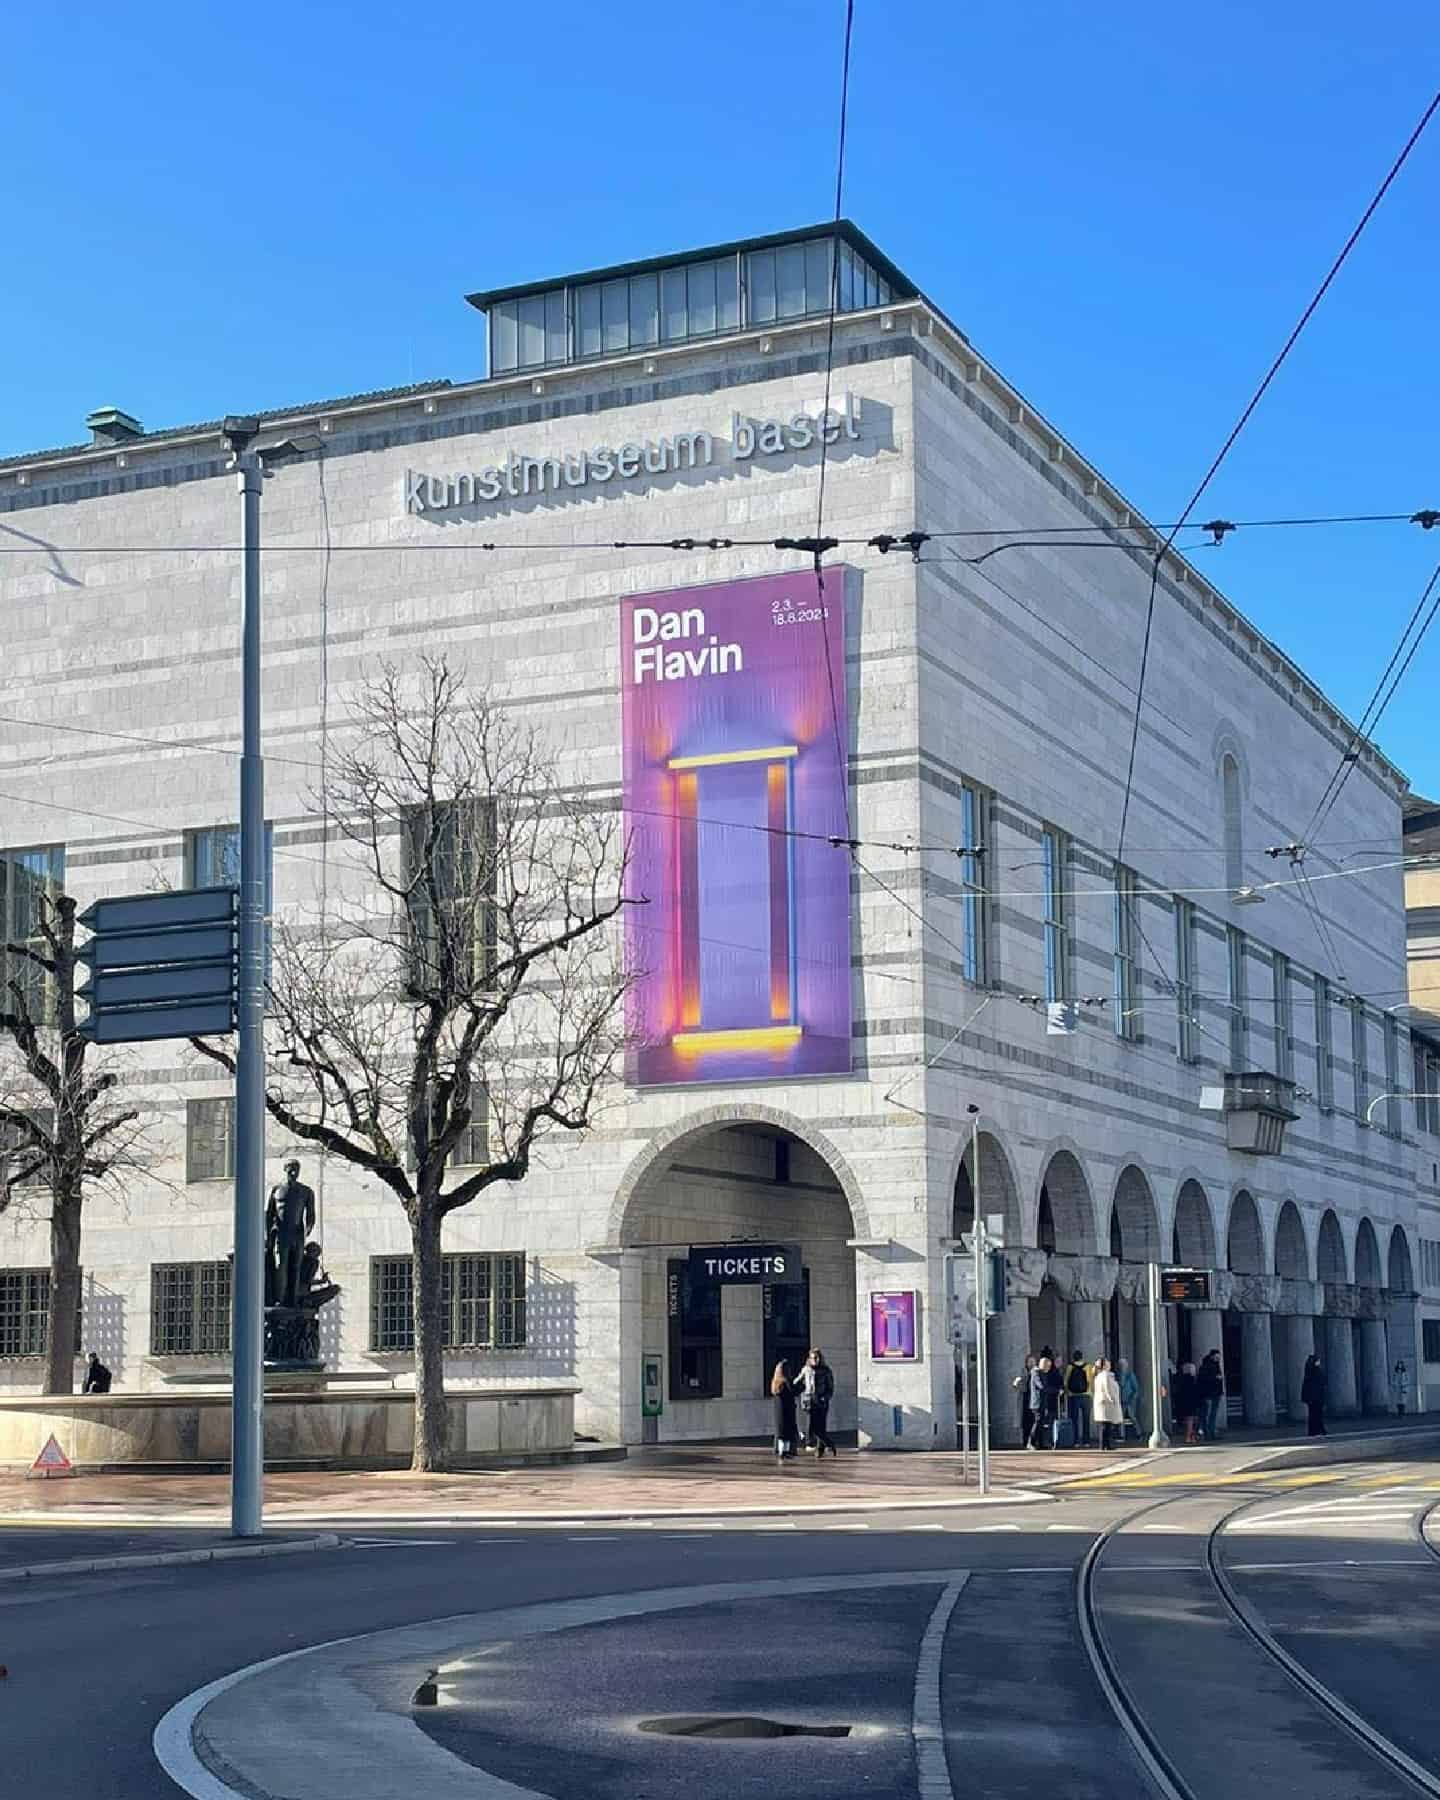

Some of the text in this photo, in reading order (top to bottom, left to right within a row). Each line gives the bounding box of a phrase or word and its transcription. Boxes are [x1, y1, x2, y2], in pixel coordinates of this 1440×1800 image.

[401, 391, 861, 515] kunstmuseum basel
[633, 608, 705, 644] Dan
[634, 636, 743, 684] Flavin
[704, 1256, 785, 1275] TICKETS
